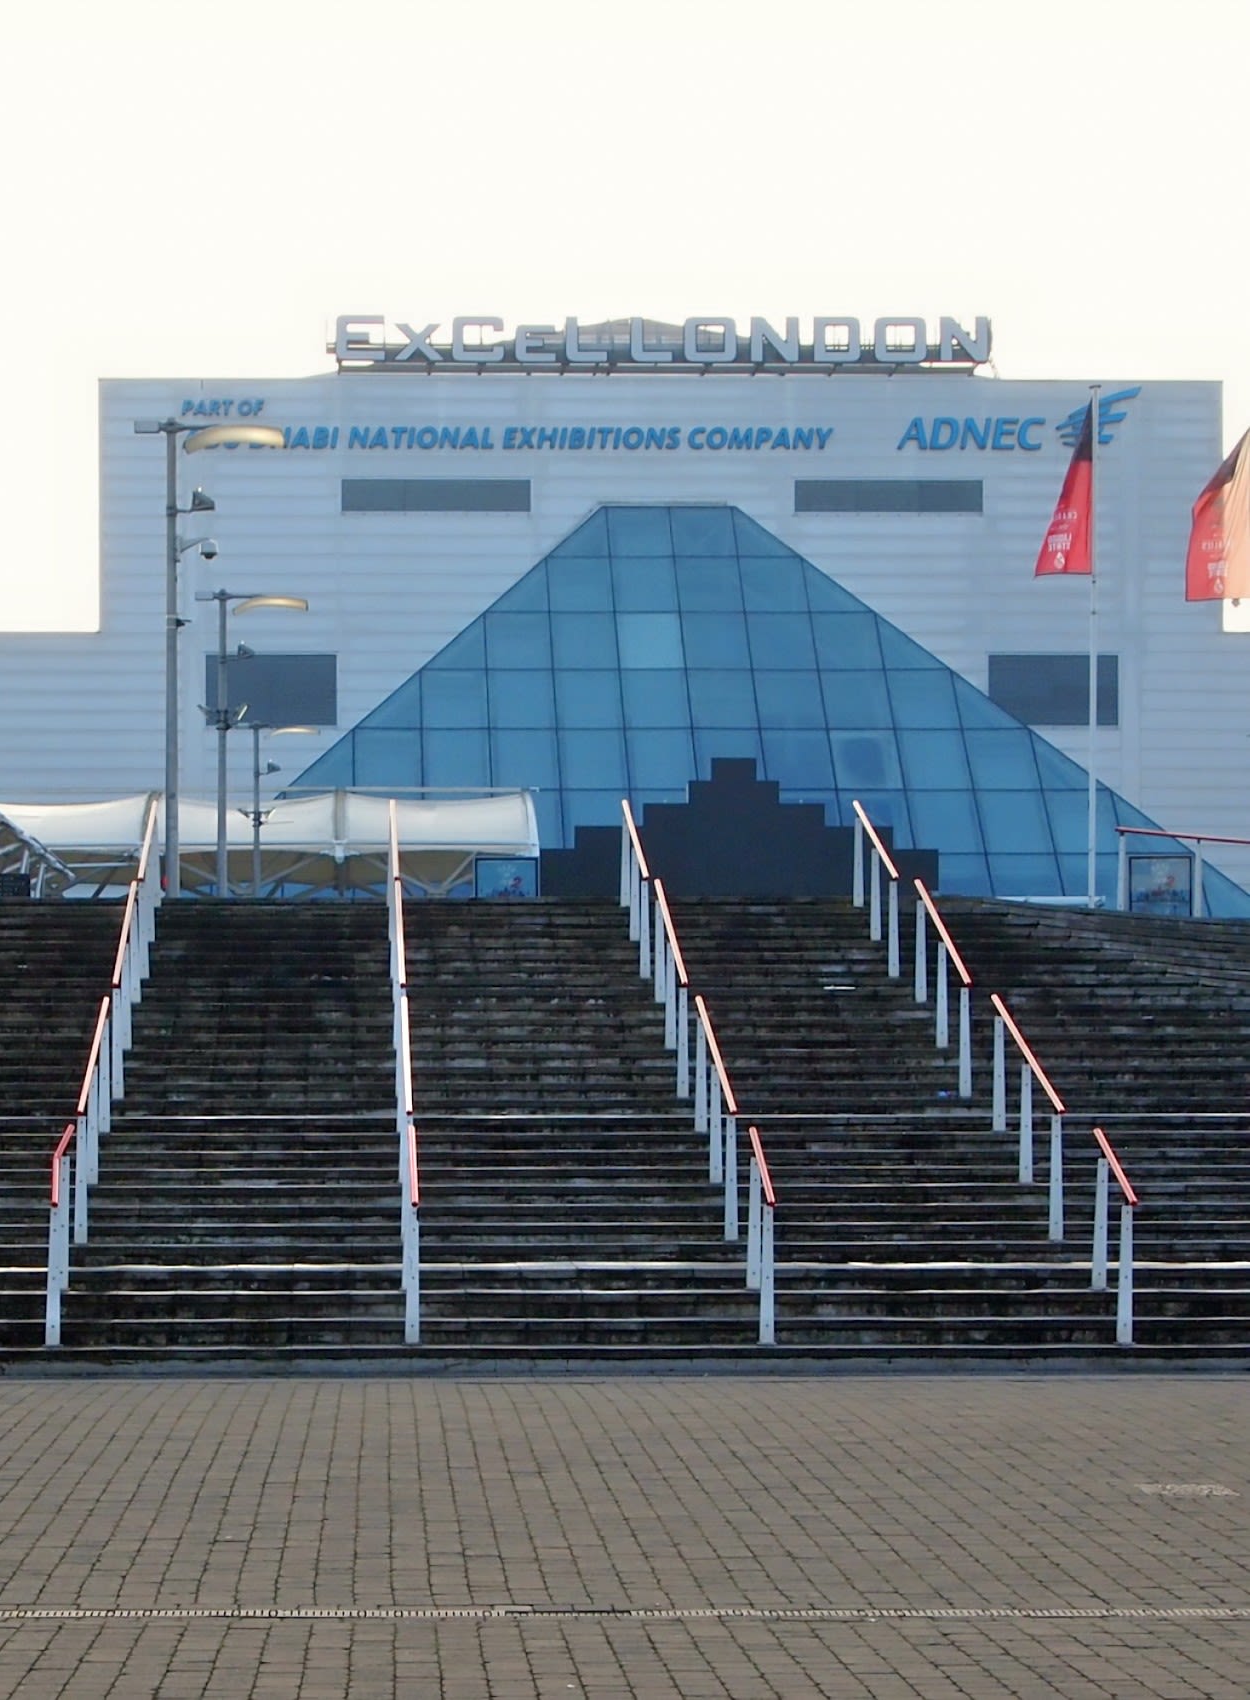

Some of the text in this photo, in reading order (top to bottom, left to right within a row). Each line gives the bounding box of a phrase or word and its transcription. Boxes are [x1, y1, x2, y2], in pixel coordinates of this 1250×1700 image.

[631, 316, 989, 363] LONDON
[181, 399, 265, 417] PART OF
[348, 426, 495, 450] NATIONAL
[502, 426, 681, 450] EXHIBITIONS
[688, 426, 833, 450] COMPANY
[897, 416, 1046, 450] ADNEC
